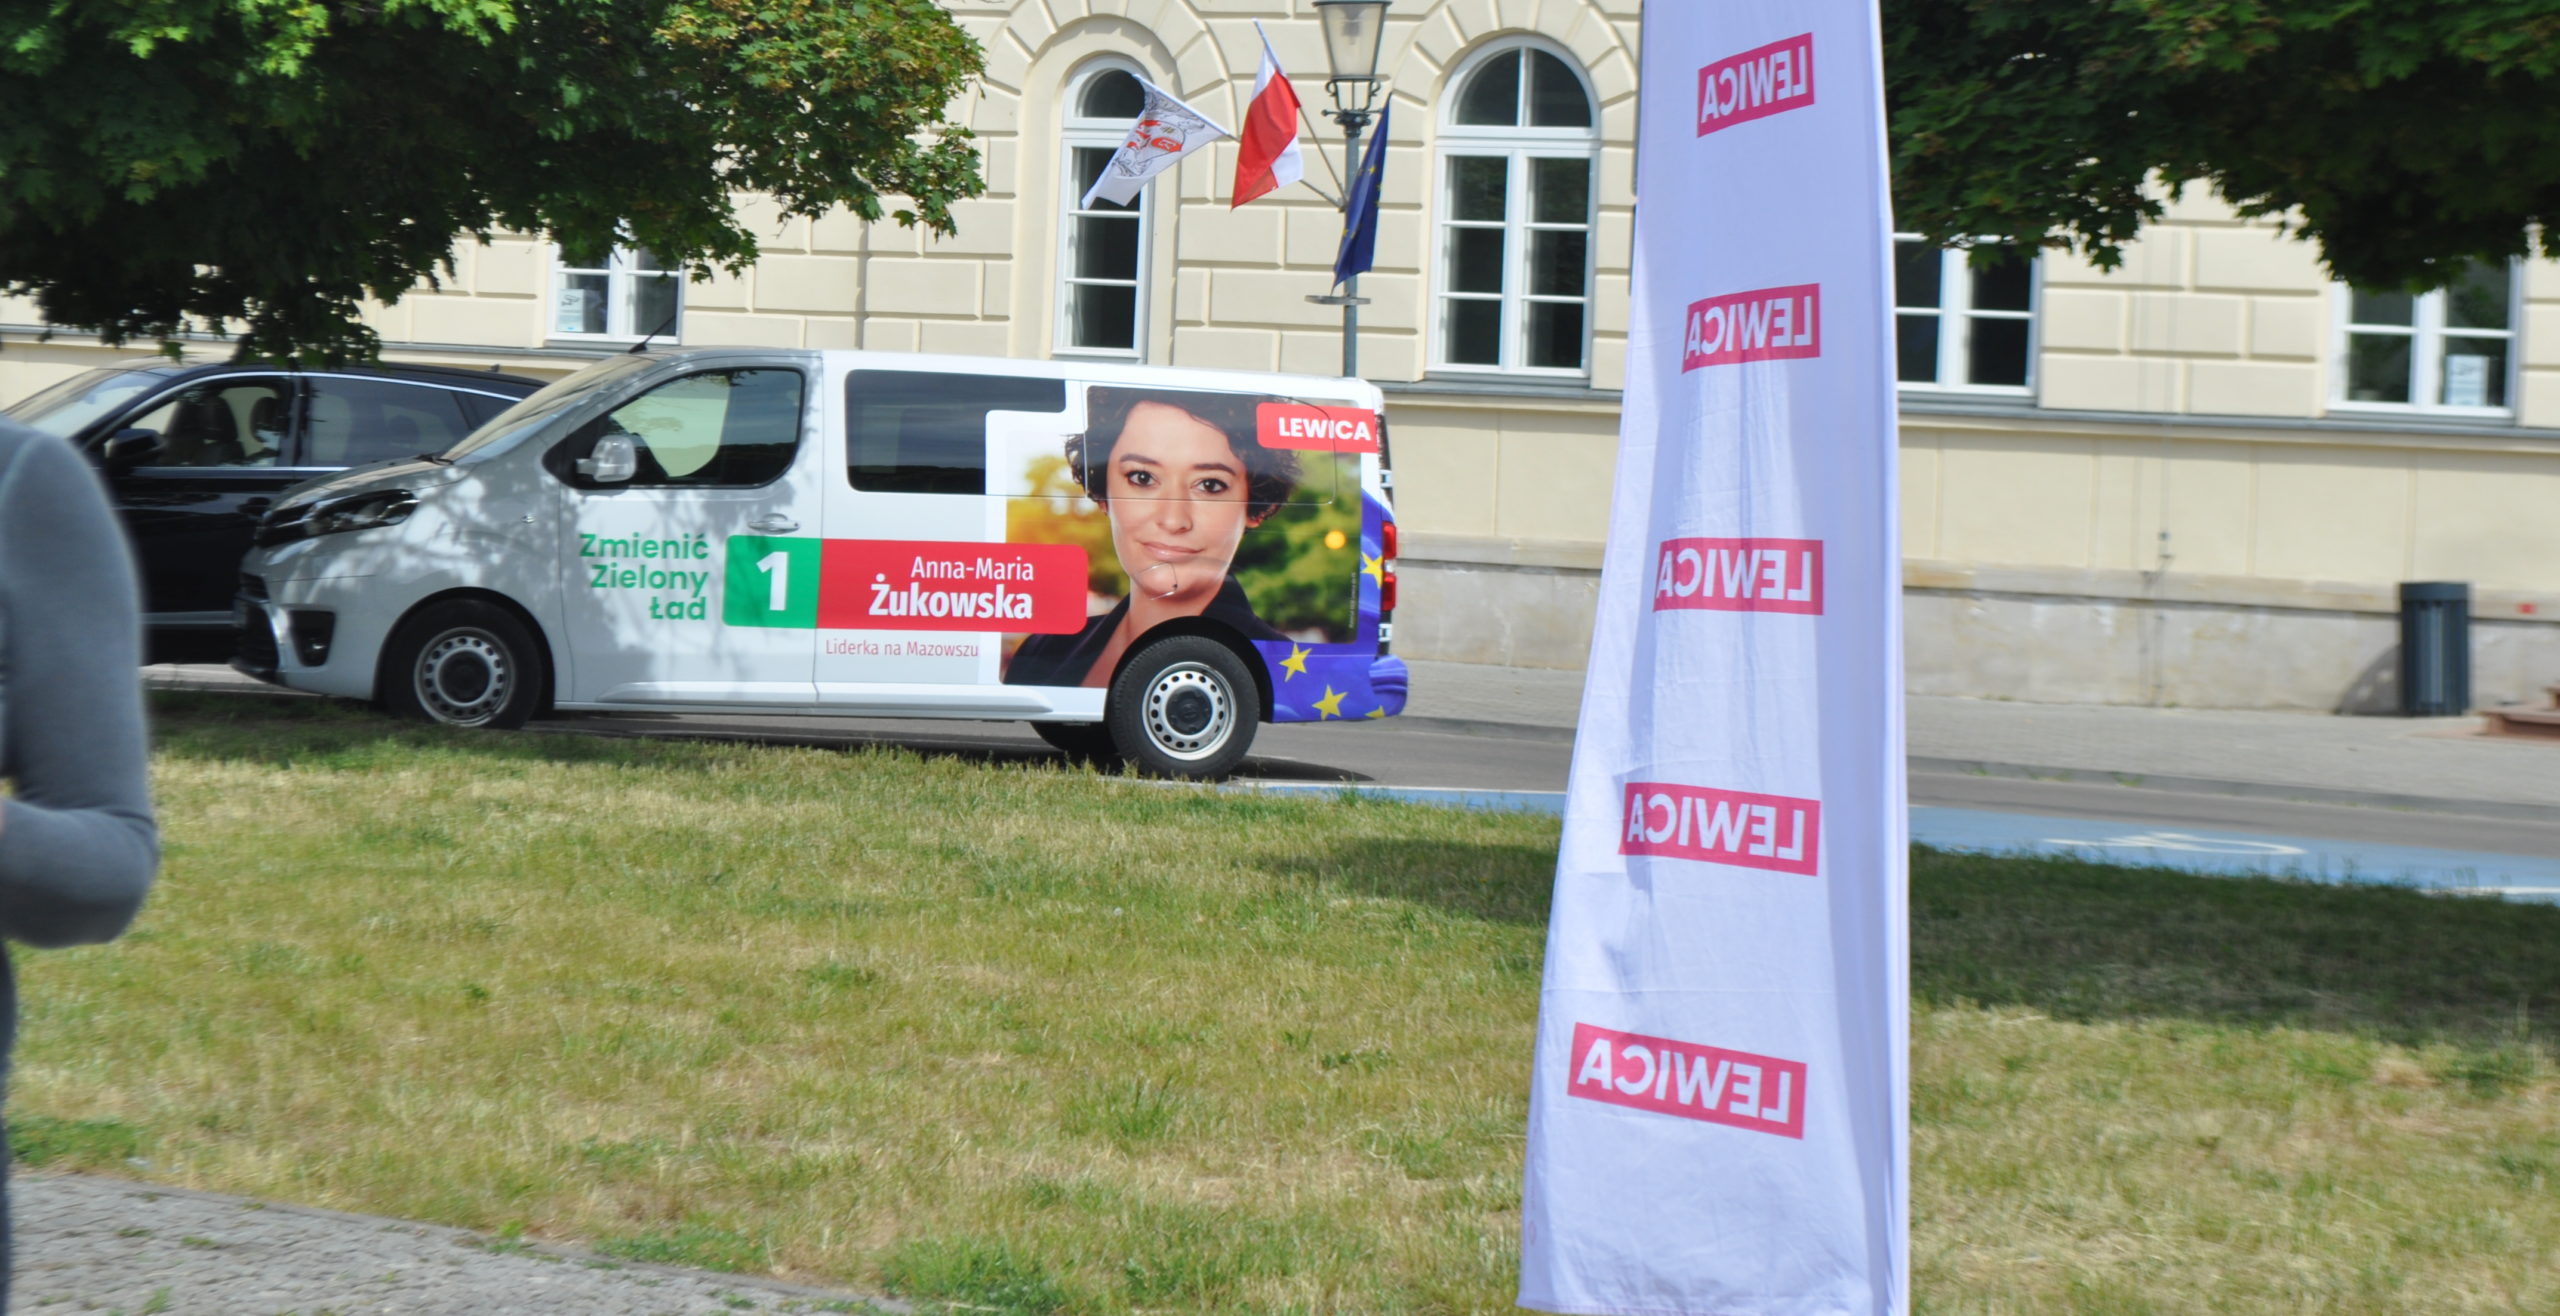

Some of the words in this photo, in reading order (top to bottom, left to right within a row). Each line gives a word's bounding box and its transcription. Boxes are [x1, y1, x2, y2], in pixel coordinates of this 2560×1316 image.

[1278, 417, 1373, 441] LEWICA
[578, 531, 709, 560] Zmienić
[590, 561, 709, 598] Zielony
[756, 551, 789, 611] 1
[910, 555, 1034, 581] Anna-Maria
[649, 596, 707, 621] Ład
[868, 573, 1033, 620] Żukowska
[825, 639, 879, 656] Liderka
[884, 643, 902, 656] na
[906, 641, 979, 657] Mazowszu
